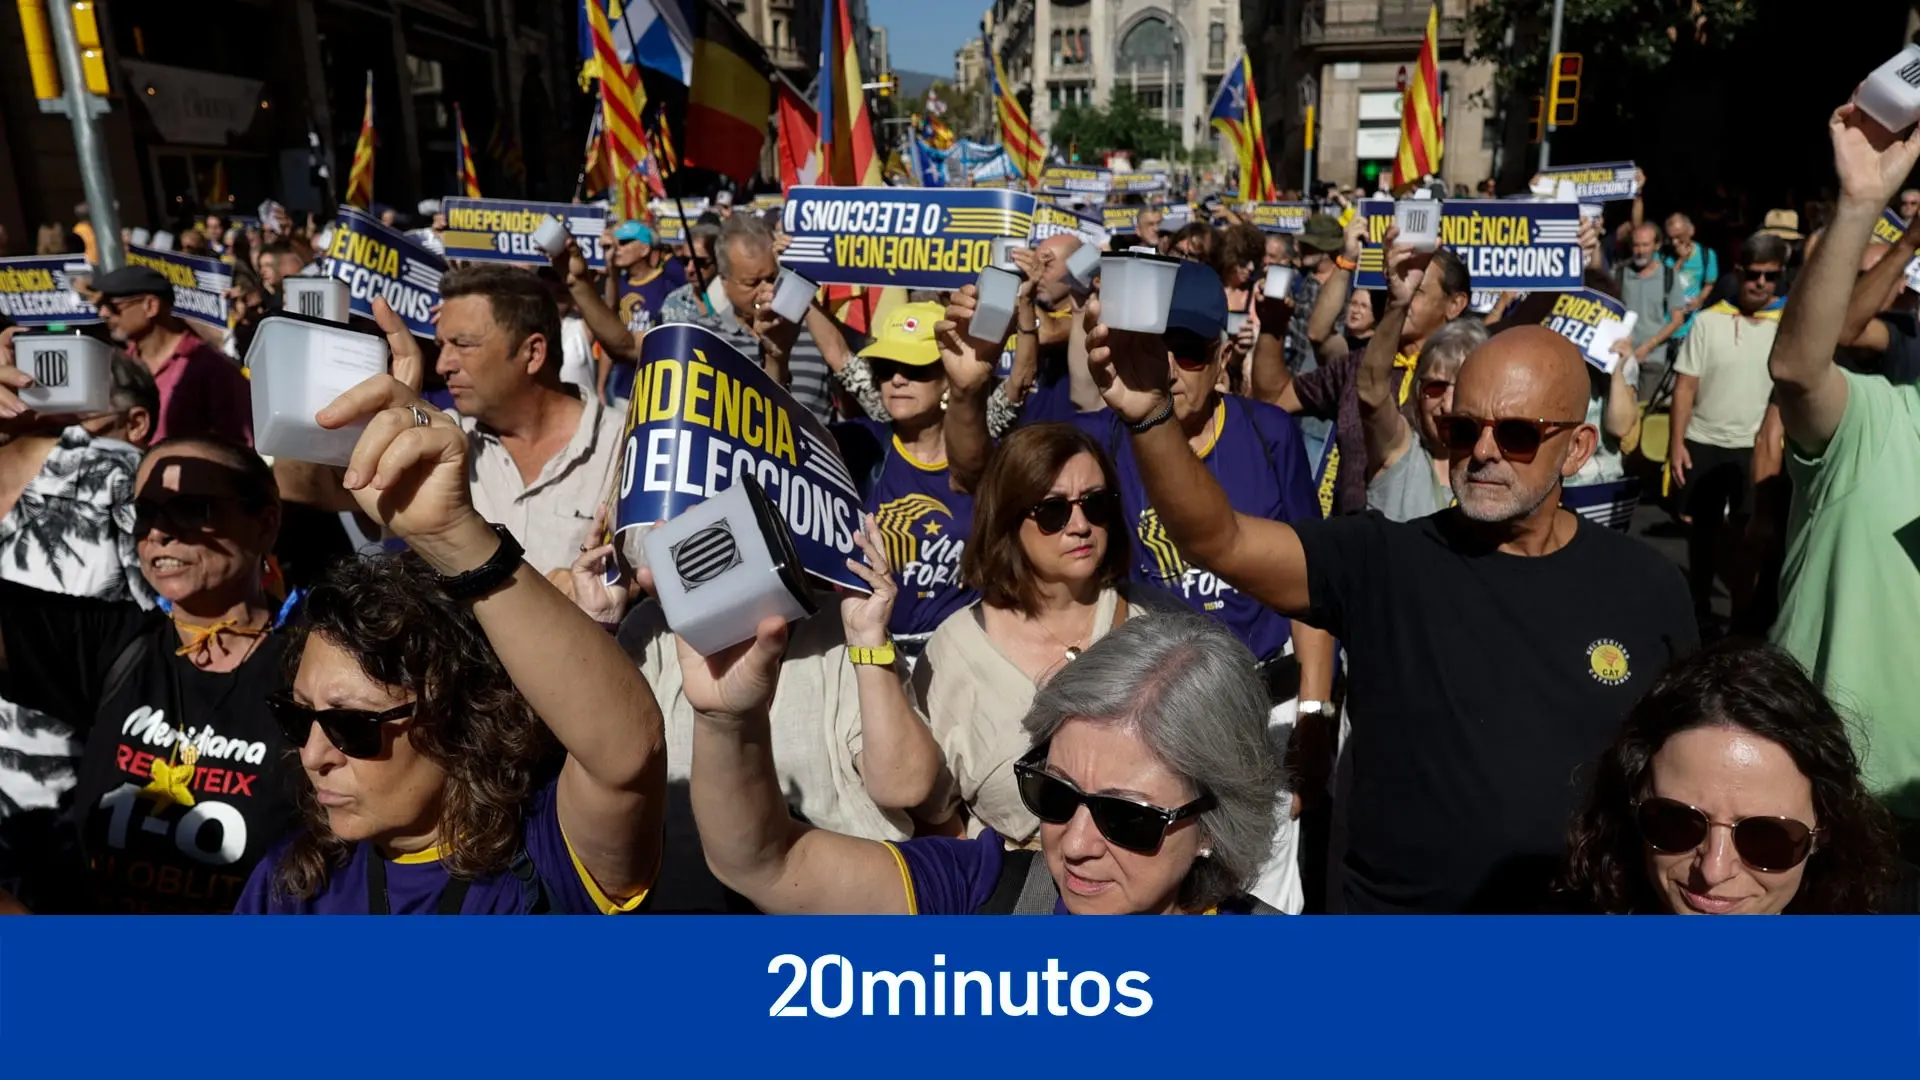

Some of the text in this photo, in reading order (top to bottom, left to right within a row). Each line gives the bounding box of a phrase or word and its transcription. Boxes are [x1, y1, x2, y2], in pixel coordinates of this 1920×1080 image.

[449, 207, 564, 235] INDEPENDÈN
[801, 199, 941, 236] O ELECCIONS
[497, 232, 510, 254] O
[620, 436, 638, 500] O
[921, 534, 965, 564] VIA
[1602, 668, 1620, 677] CAT
[121, 705, 267, 765] Meridiana
[116, 744, 257, 796] RETEIX
